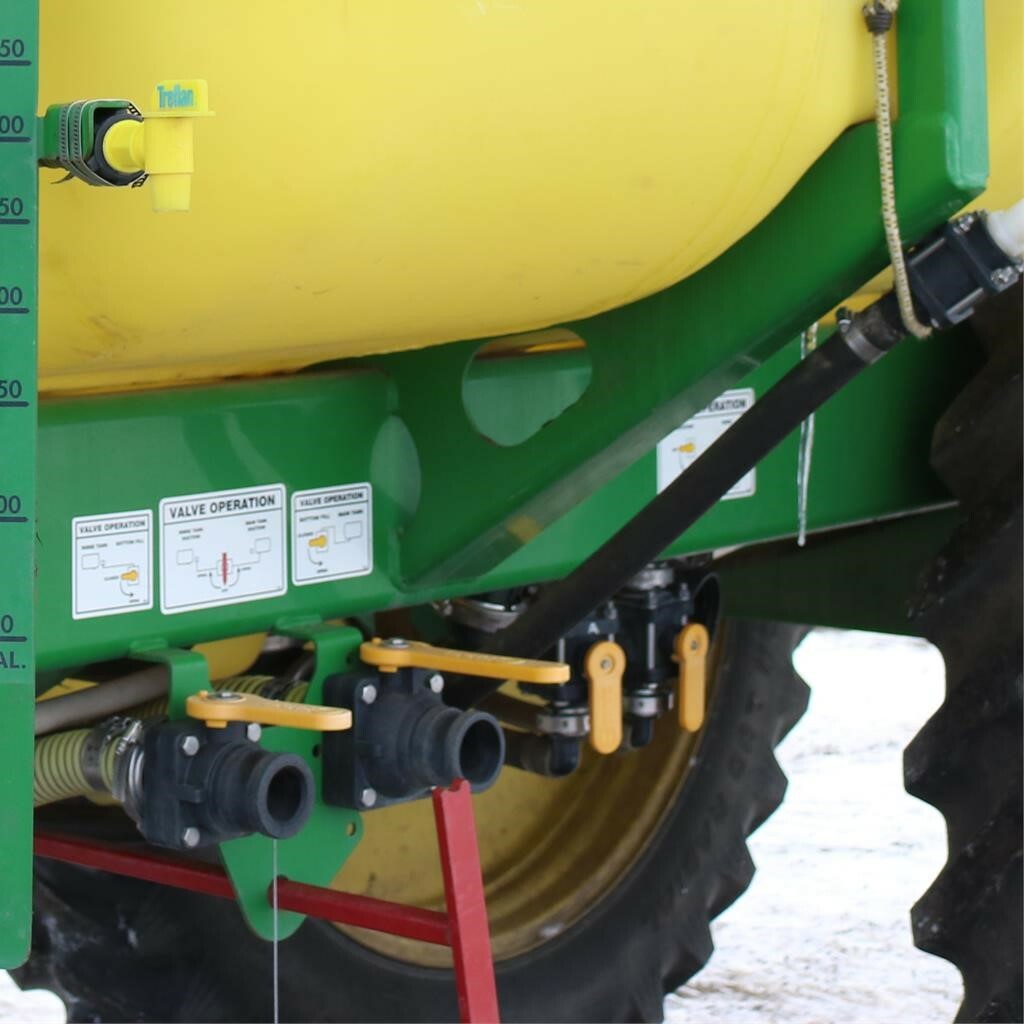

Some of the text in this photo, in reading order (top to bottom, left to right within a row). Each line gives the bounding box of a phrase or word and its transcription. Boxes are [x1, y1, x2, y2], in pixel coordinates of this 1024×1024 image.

[169, 495, 276, 519] VALVE OPERATION
[301, 492, 364, 507] VALVE OPERATION
[79, 520, 145, 534] VALVE OPERATION
